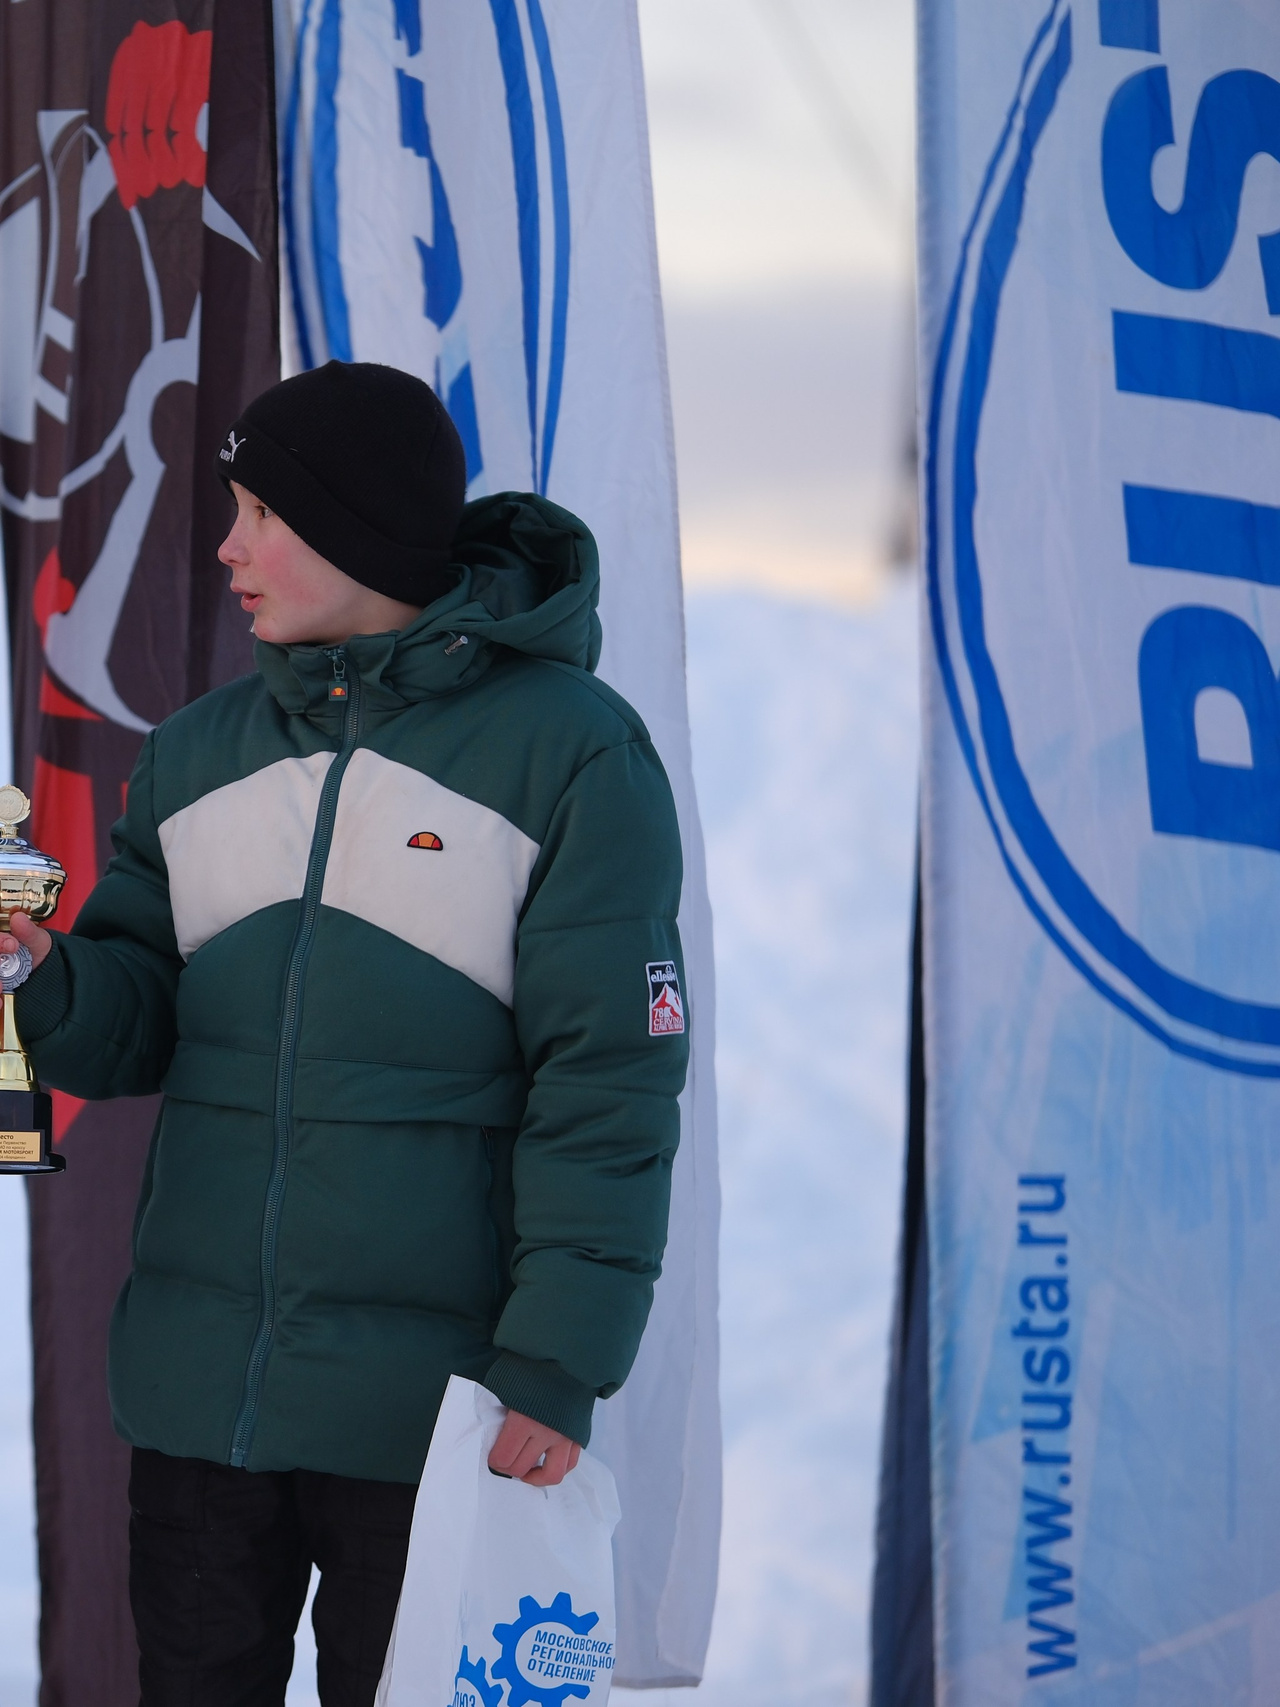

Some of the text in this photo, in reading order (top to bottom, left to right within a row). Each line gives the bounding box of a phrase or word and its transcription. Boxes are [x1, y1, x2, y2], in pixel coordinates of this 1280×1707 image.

[1011, 1173, 1078, 1680] www.rusta.ru
[534, 1630, 614, 1655] МОСКОВСКОЕ
[527, 1658, 596, 1682] ОТДЕЛЕНИЕ
